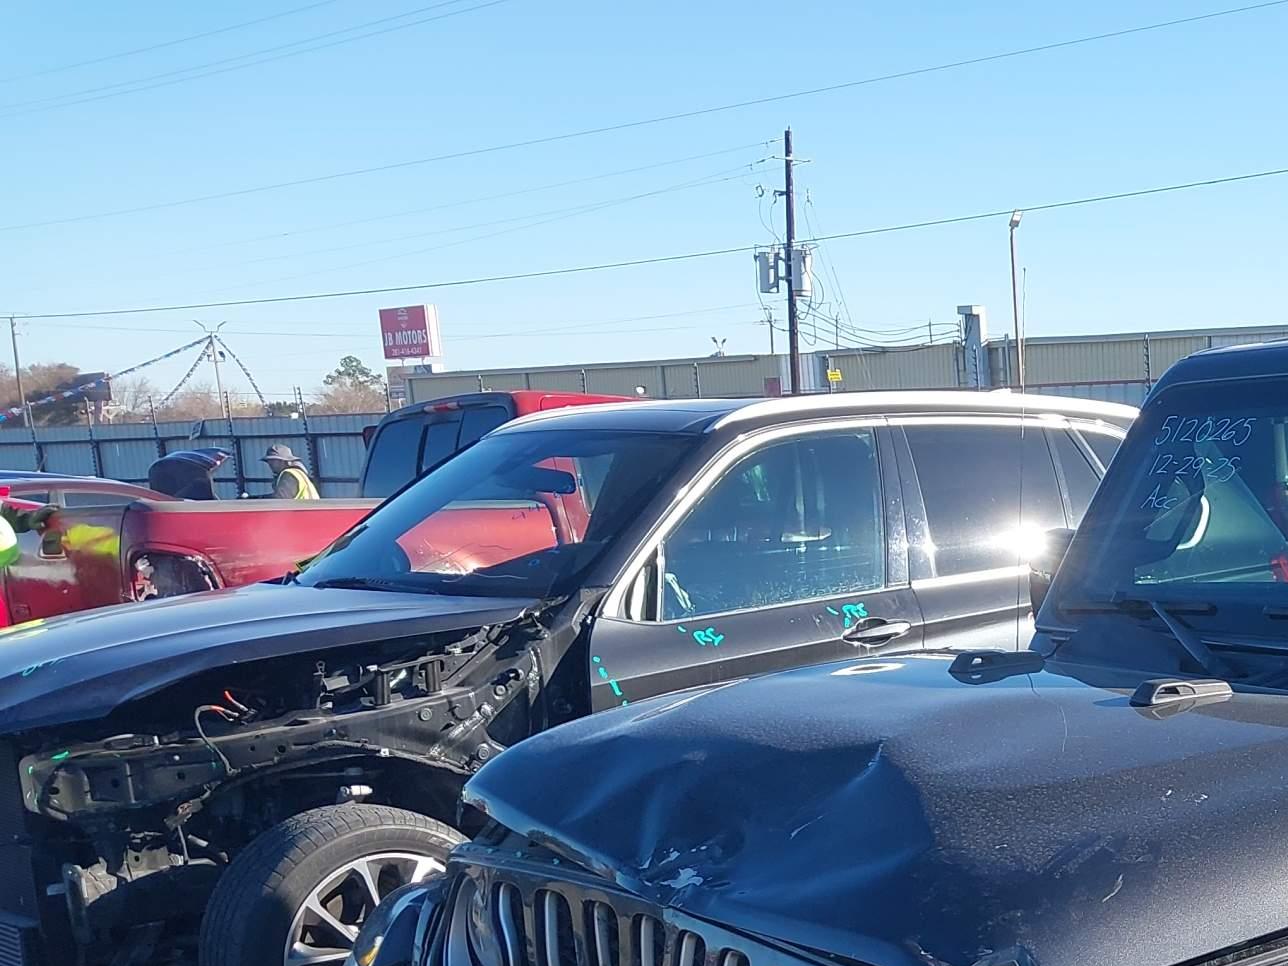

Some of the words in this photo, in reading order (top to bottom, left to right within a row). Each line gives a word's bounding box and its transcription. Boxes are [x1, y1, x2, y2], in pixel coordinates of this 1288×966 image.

[384, 332, 394, 346] JB
[395, 329, 427, 346] MOTORS
[1155, 416, 1257, 445] 5120265
[1149, 454, 1241, 482] 12-29-25
